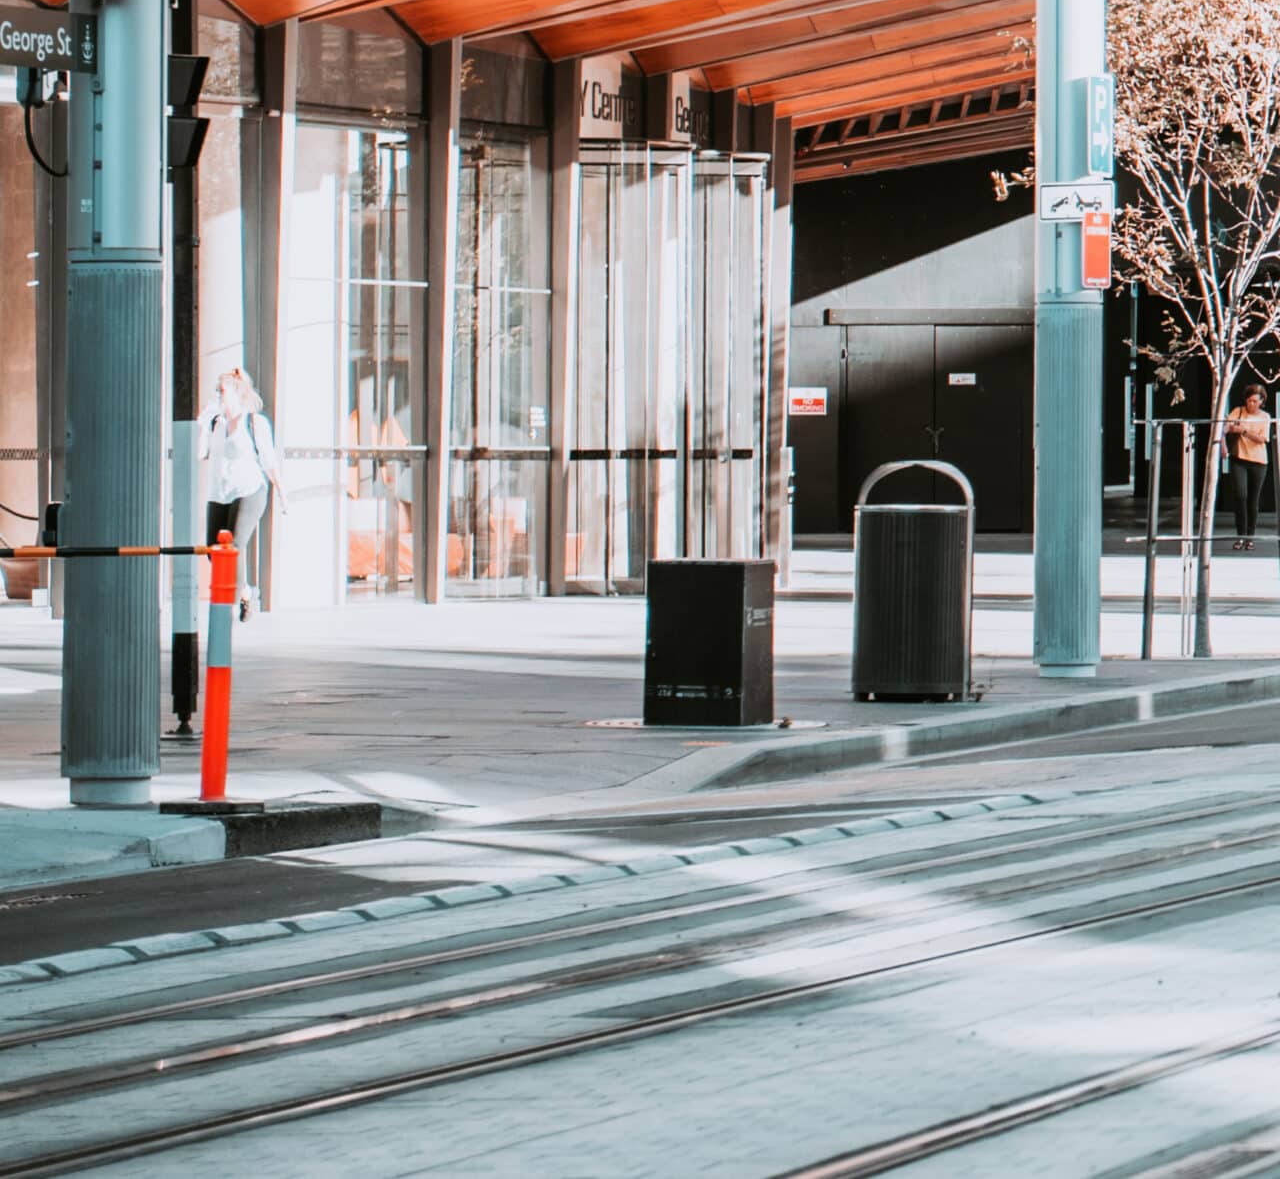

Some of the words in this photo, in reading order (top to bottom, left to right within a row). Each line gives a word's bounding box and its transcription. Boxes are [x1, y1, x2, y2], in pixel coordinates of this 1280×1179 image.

[0, 20, 54, 62] George
[57, 27, 73, 57] St
[1095, 85, 1107, 124] P
